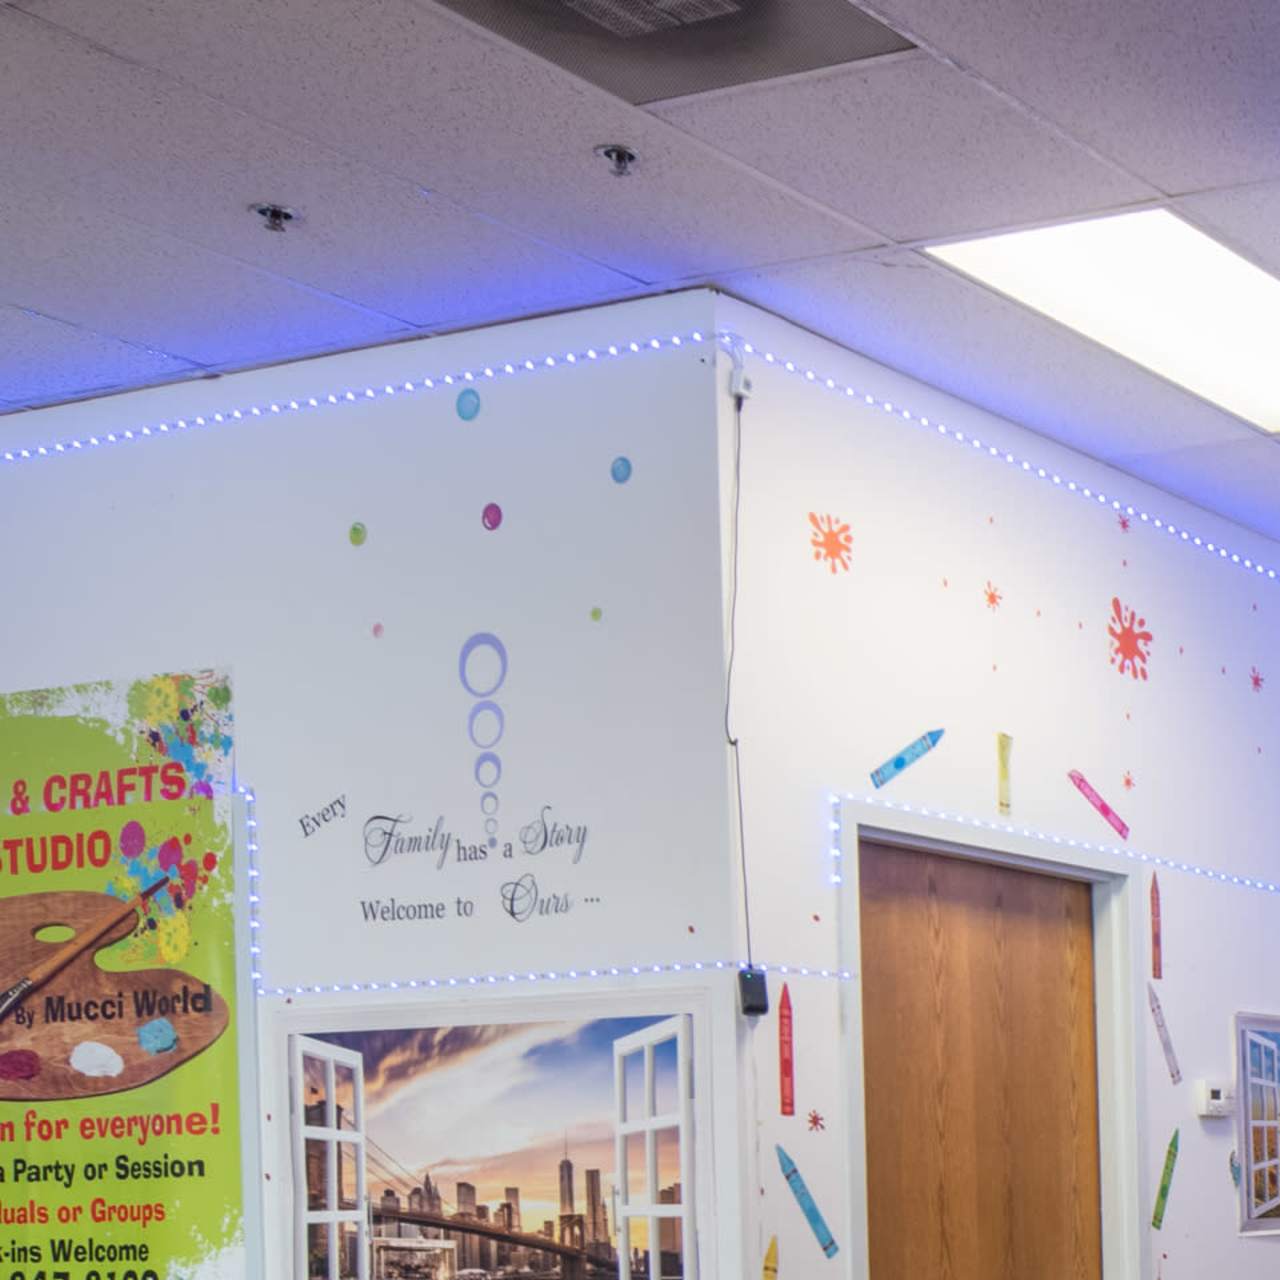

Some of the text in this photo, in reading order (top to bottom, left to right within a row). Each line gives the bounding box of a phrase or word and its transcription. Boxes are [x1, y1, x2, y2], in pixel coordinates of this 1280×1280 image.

[10, 761, 187, 816] & CRAFTS
[0, 829, 111, 876] TUDIO
[298, 794, 590, 871] Every Family has a Story
[360, 897, 446, 922] Welcome
[456, 896, 474, 918] to
[500, 873, 572, 923] Ours
[14, 984, 213, 1029] By Mucci World
[24, 1109, 69, 1142] for
[79, 1103, 220, 1146] everyone!
[13, 1157, 75, 1188] Party
[84, 1162, 108, 1182] or
[115, 1153, 205, 1181] Session
[57, 1205, 82, 1224] or
[90, 1198, 166, 1228] Groups
[49, 1238, 149, 1264] Welcome
